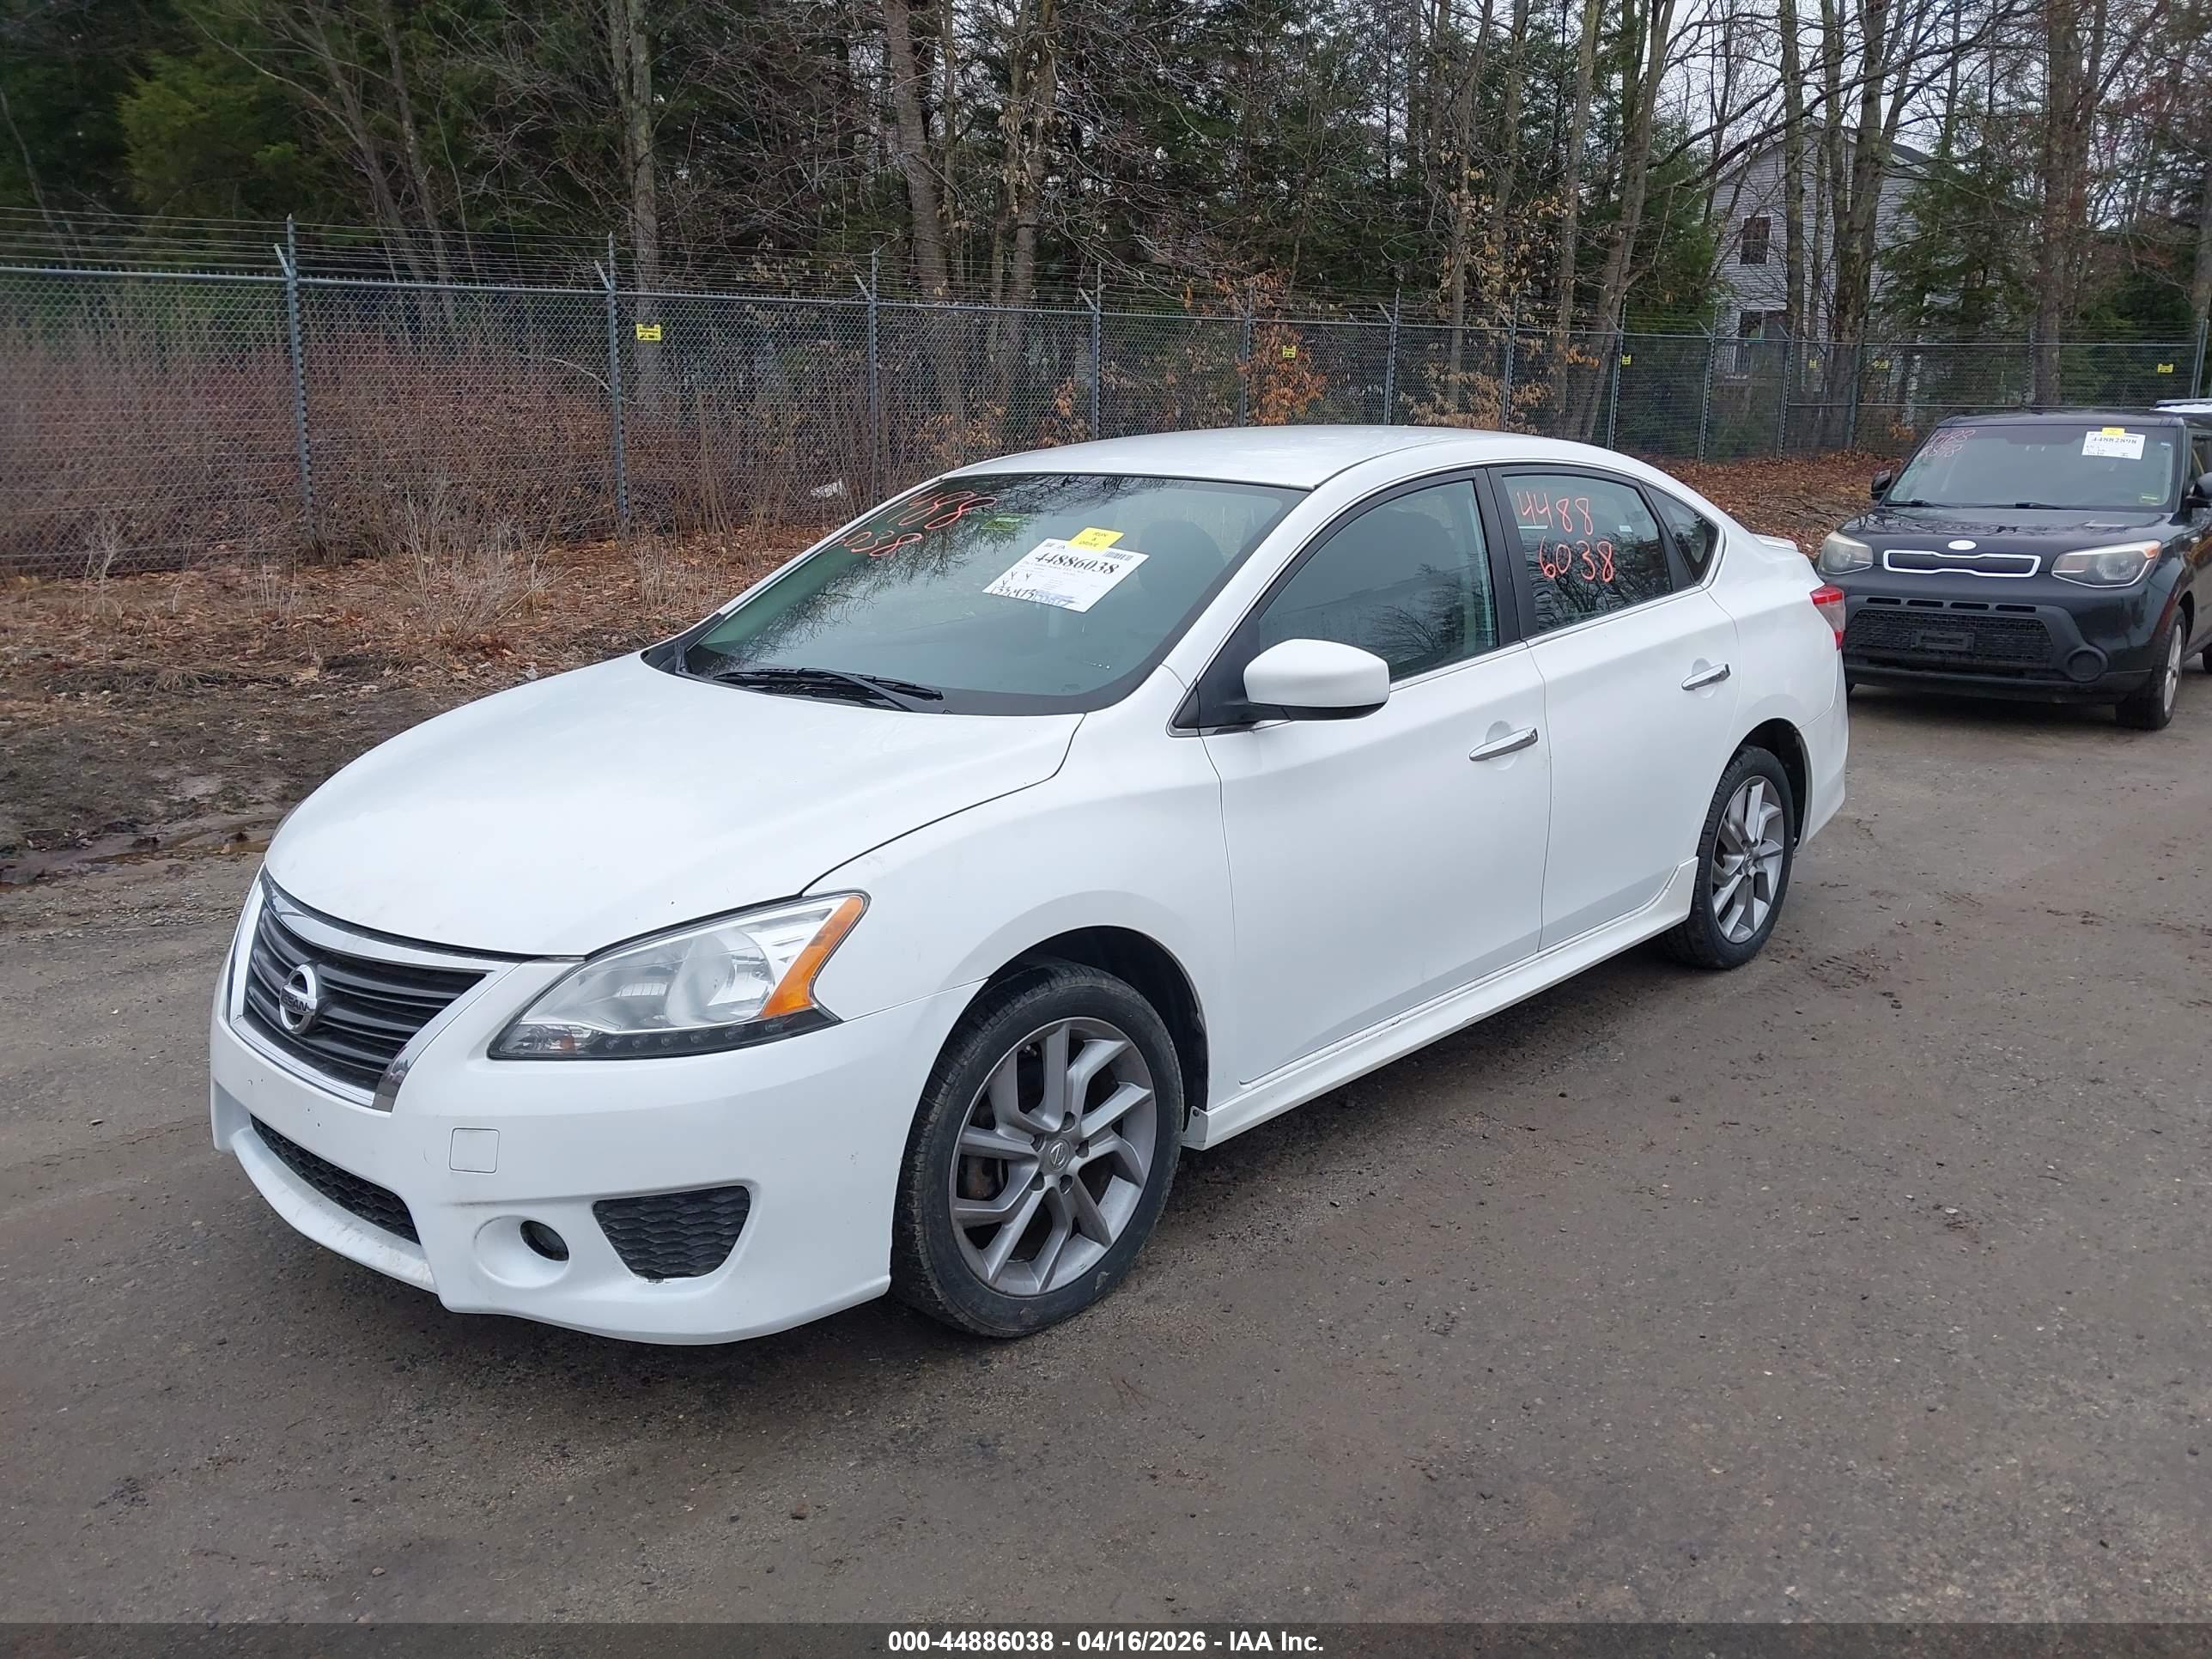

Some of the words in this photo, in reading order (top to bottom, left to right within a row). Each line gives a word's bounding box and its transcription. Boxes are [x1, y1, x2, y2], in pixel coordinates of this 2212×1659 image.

[1516, 490, 1594, 535] 4488
[836, 531, 923, 556] 038
[1539, 536, 1614, 582] 6038
[1035, 552, 1120, 575] 44886038
